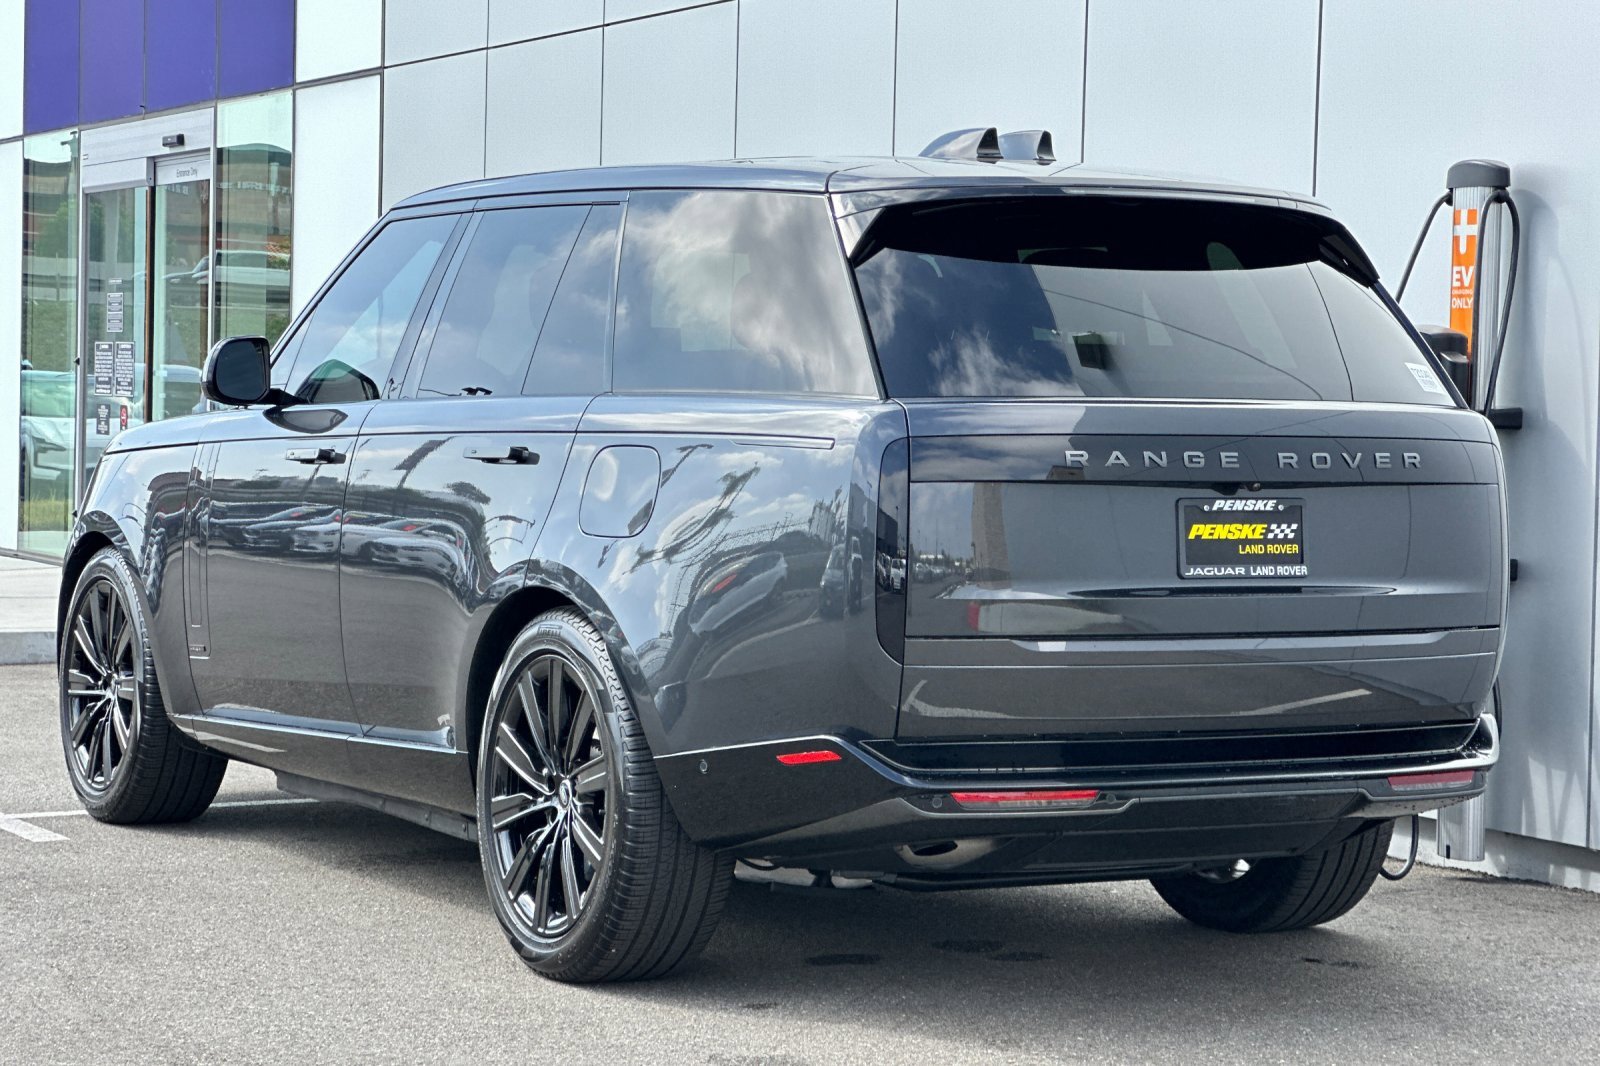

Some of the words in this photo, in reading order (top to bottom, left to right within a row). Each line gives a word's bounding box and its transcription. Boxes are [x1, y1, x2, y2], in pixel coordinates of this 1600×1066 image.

[1453, 266, 1474, 287] EV
[1452, 297, 1473, 309] ONLY
[1064, 450, 1240, 469] RANGE
[1277, 451, 1423, 470] ROVER
[1212, 500, 1277, 511] PENSKE
[1188, 524, 1267, 540] PENSKE
[1239, 544, 1265, 555] LAND
[1267, 544, 1299, 555] ROVER
[1185, 567, 1246, 576] JAGUAR
[1250, 566, 1275, 576] LAND
[1277, 566, 1307, 576] ROVER
